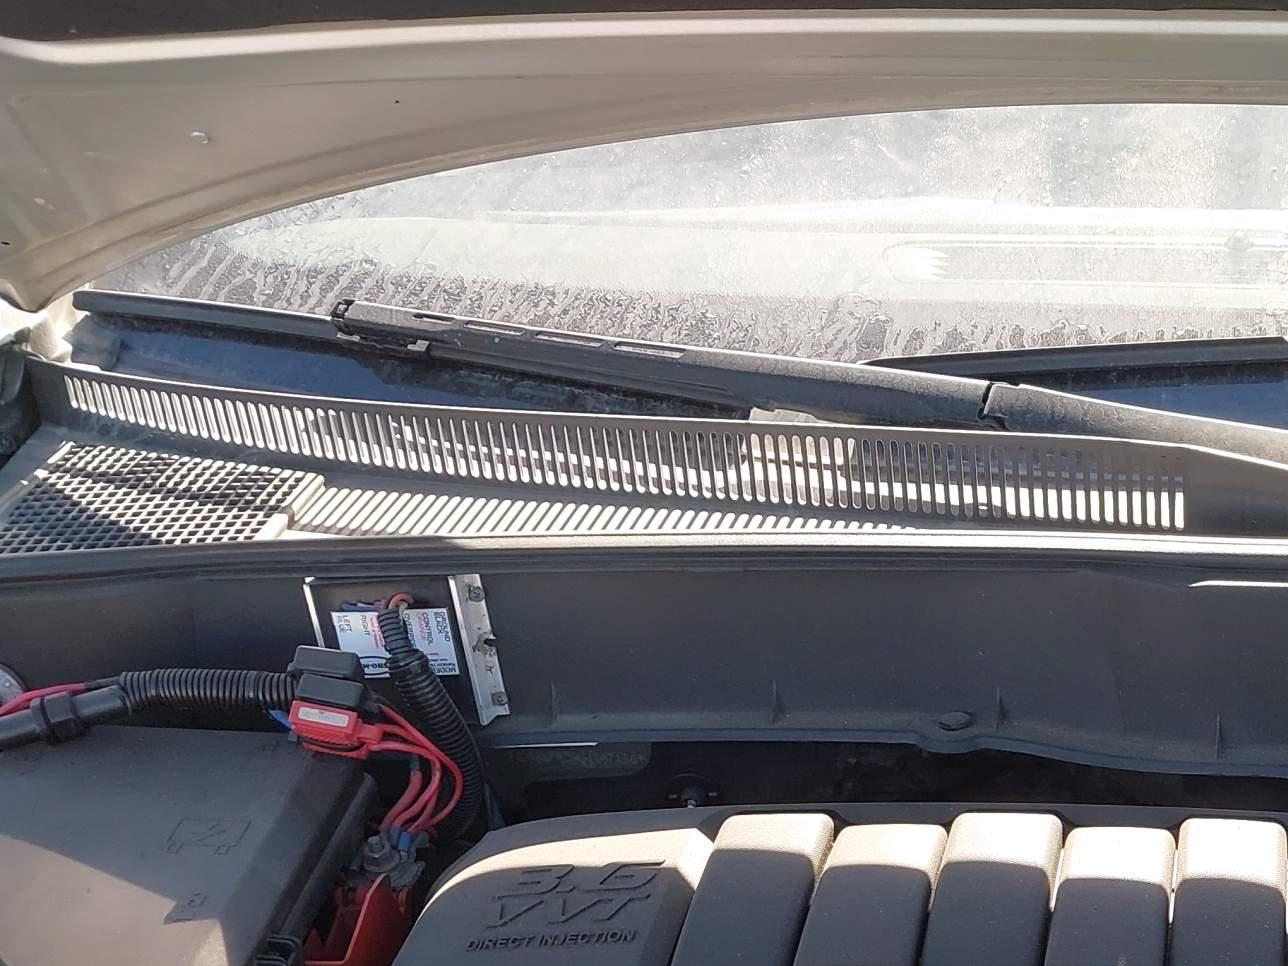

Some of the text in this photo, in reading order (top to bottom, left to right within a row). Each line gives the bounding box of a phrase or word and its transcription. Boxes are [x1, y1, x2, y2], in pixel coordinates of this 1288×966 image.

[497, 859, 666, 898] 3.6
[485, 894, 651, 928] VVT
[466, 930, 638, 952] DIRECT INJECTION
